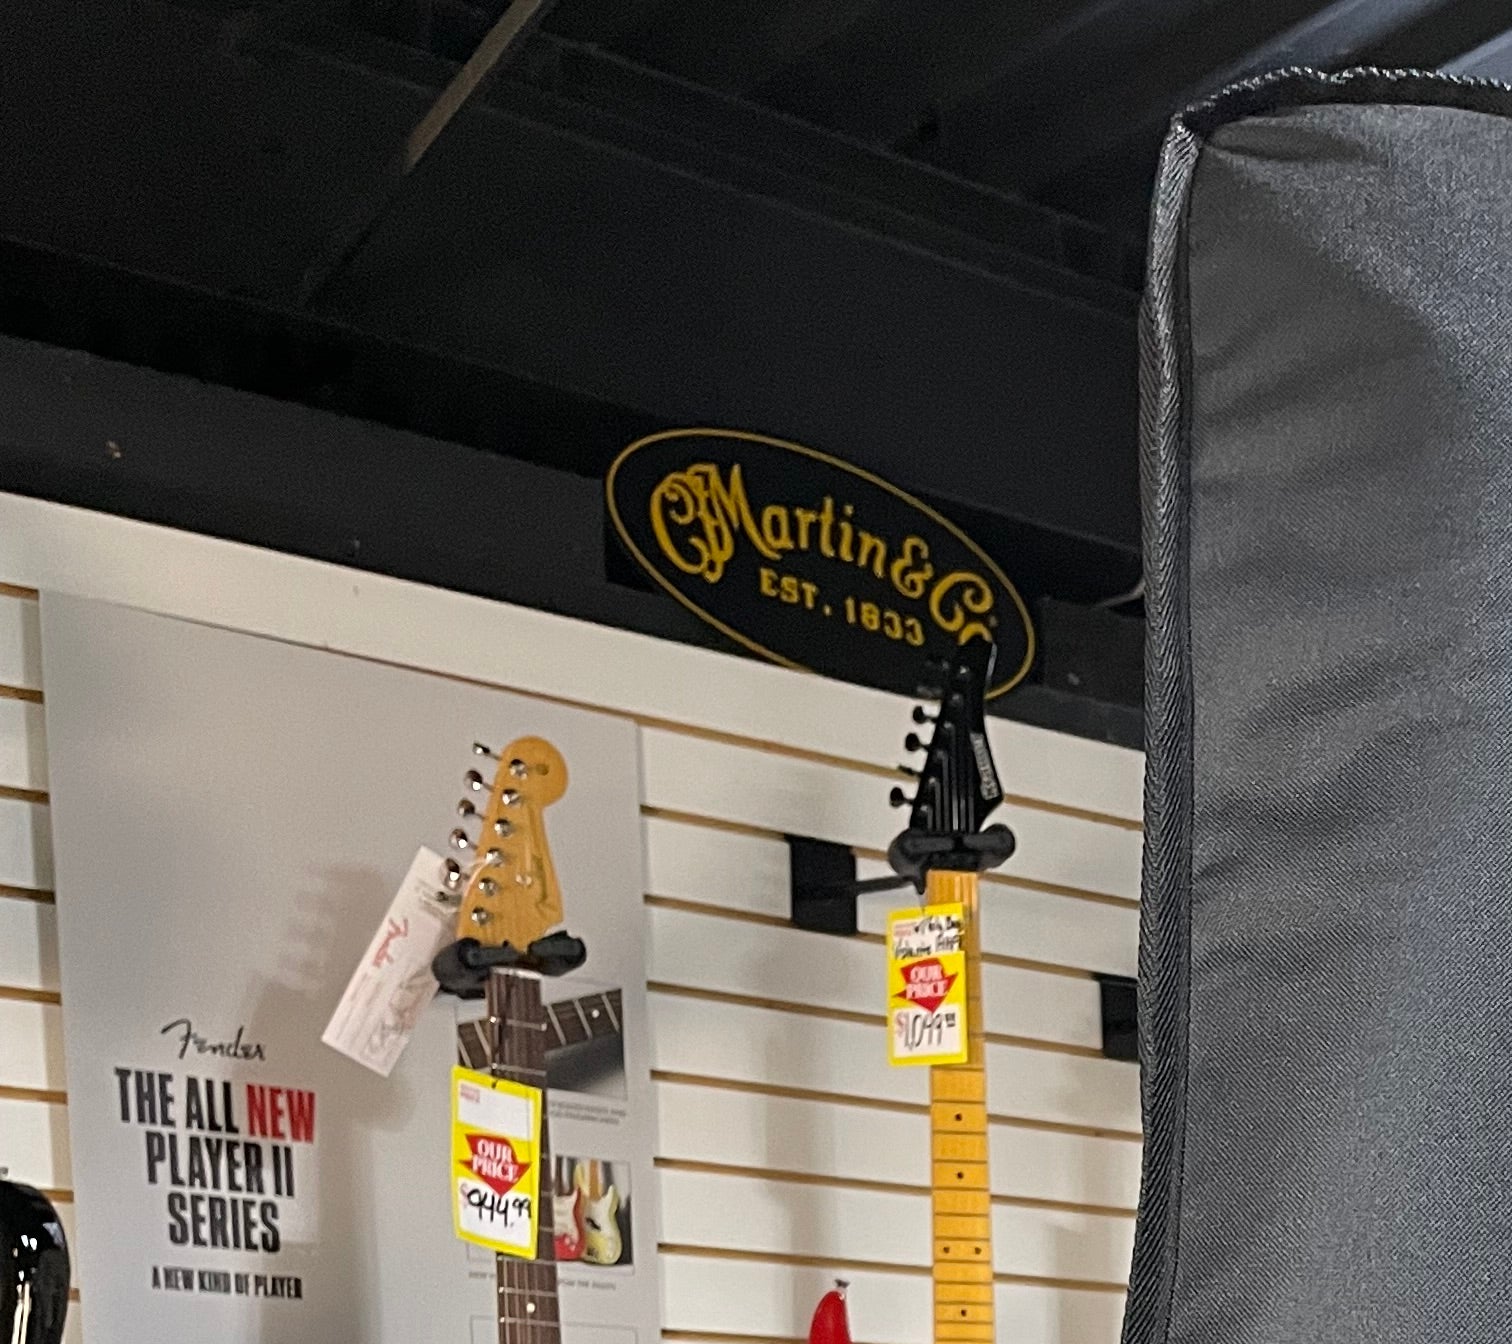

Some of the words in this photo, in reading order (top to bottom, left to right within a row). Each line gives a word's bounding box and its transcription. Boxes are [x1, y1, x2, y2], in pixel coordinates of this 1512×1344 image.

[759, 567, 832, 617] EST.
[845, 597, 926, 647] 1833
[160, 1018, 266, 1060] Fender
[114, 1066, 176, 1127] THE
[185, 1076, 239, 1134] ALL
[246, 1083, 315, 1144] NEW
[145, 1131, 265, 1195] PLAYER
[272, 1145, 295, 1198] II
[472, 1154, 520, 1183] PRICE
[477, 1138, 514, 1163] OUR
[167, 1192, 281, 1254] SERIES
[152, 1266, 161, 1290] A
[163, 1267, 195, 1292] NEW
[254, 1274, 303, 1300] PLAYER
